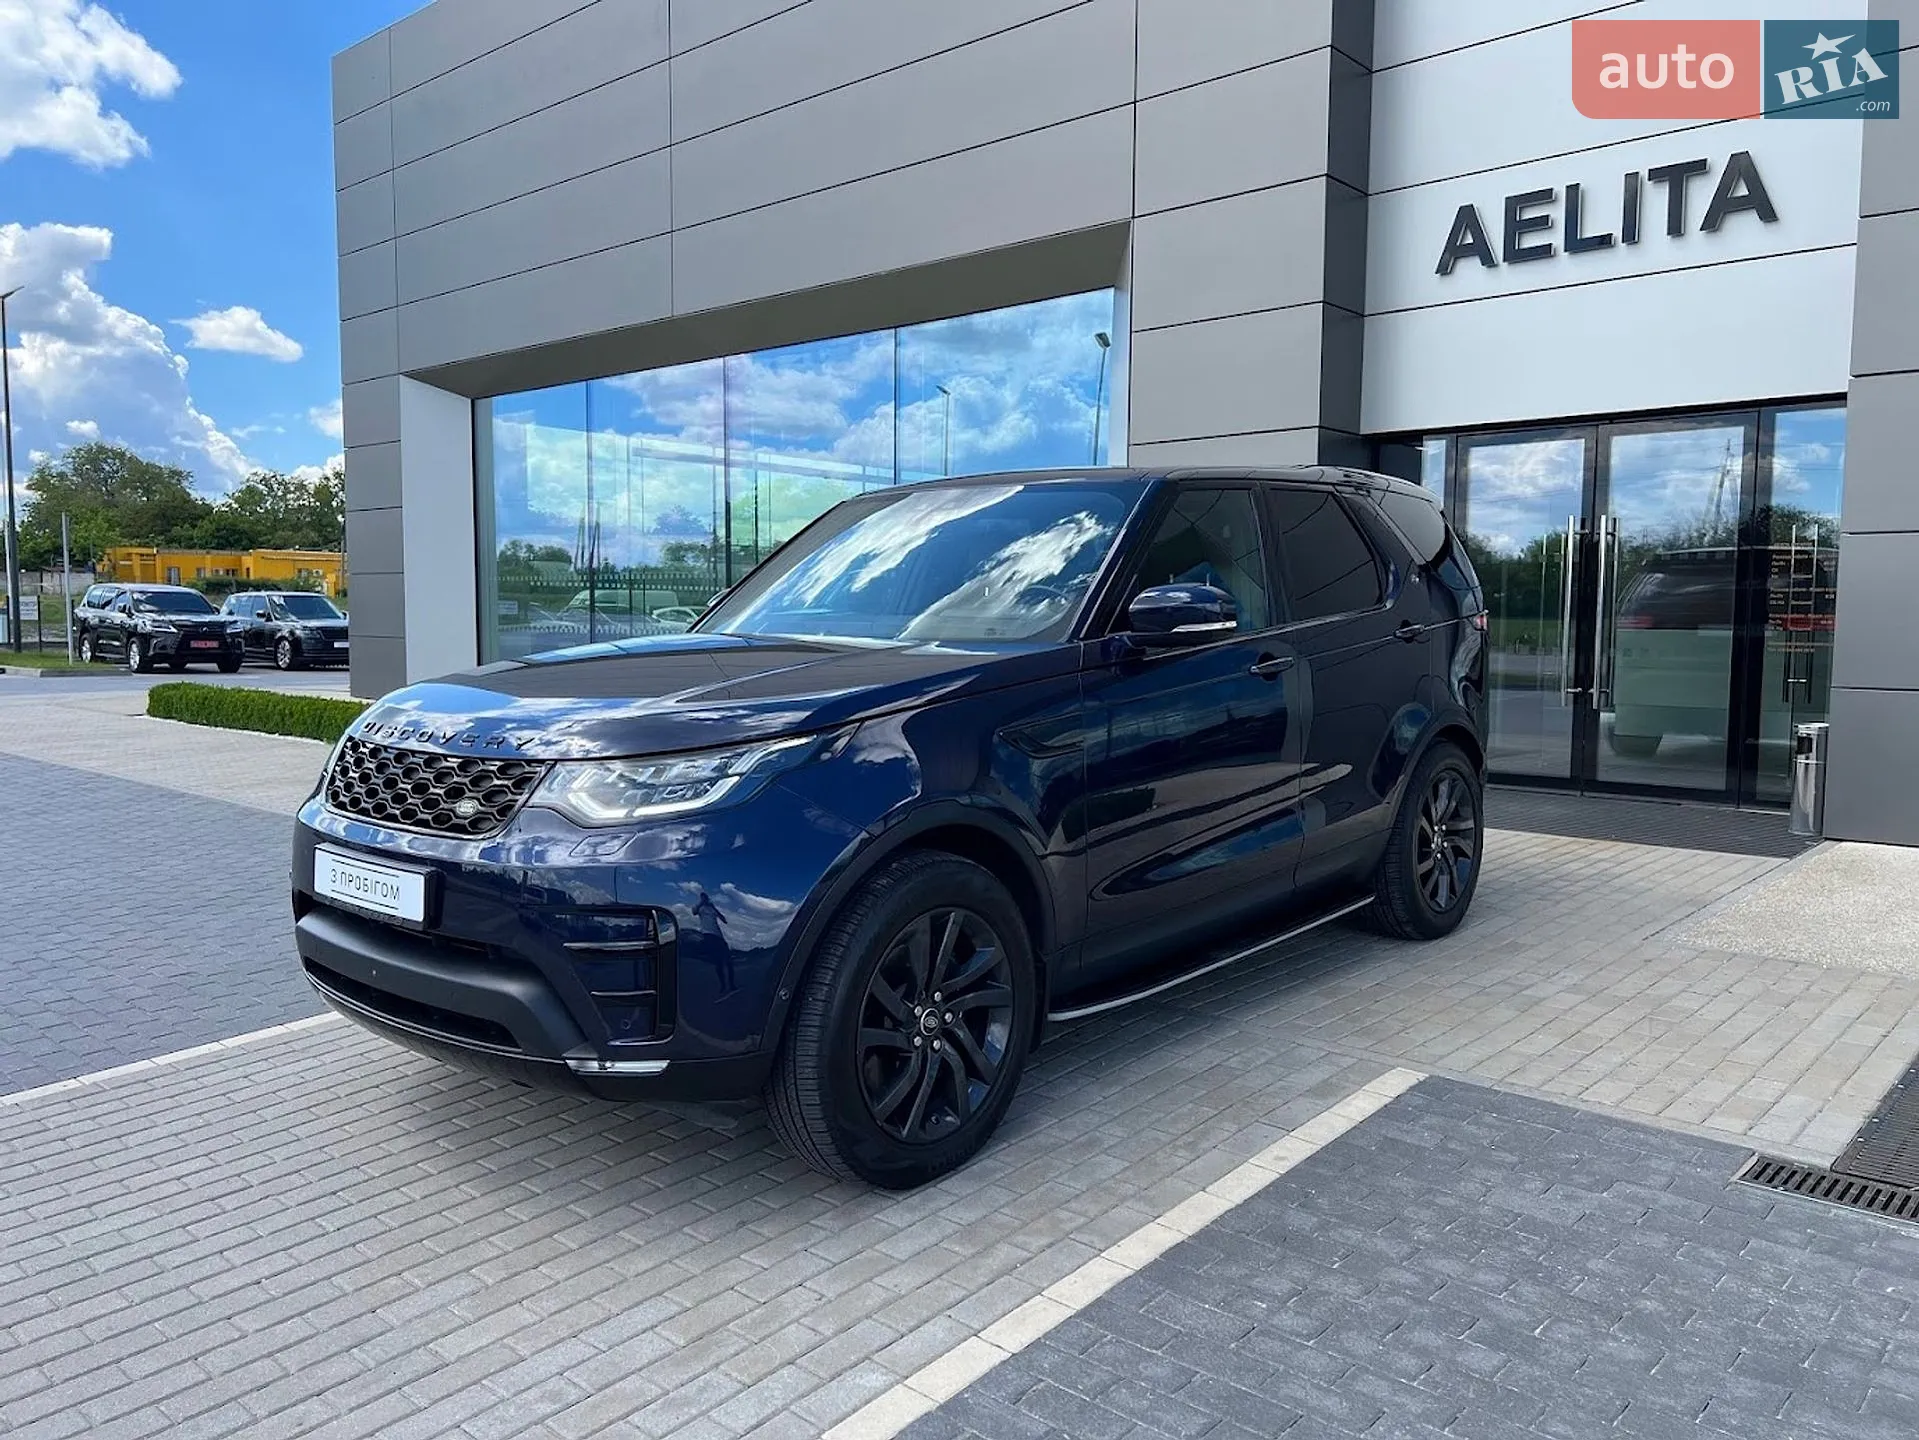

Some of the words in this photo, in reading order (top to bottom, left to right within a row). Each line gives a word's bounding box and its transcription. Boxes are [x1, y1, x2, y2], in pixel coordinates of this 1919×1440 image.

[1435, 150, 1779, 276] AELITA
[362, 721, 536, 751] DISCOVERY
[340, 871, 400, 900] ПРОБІГОМ
